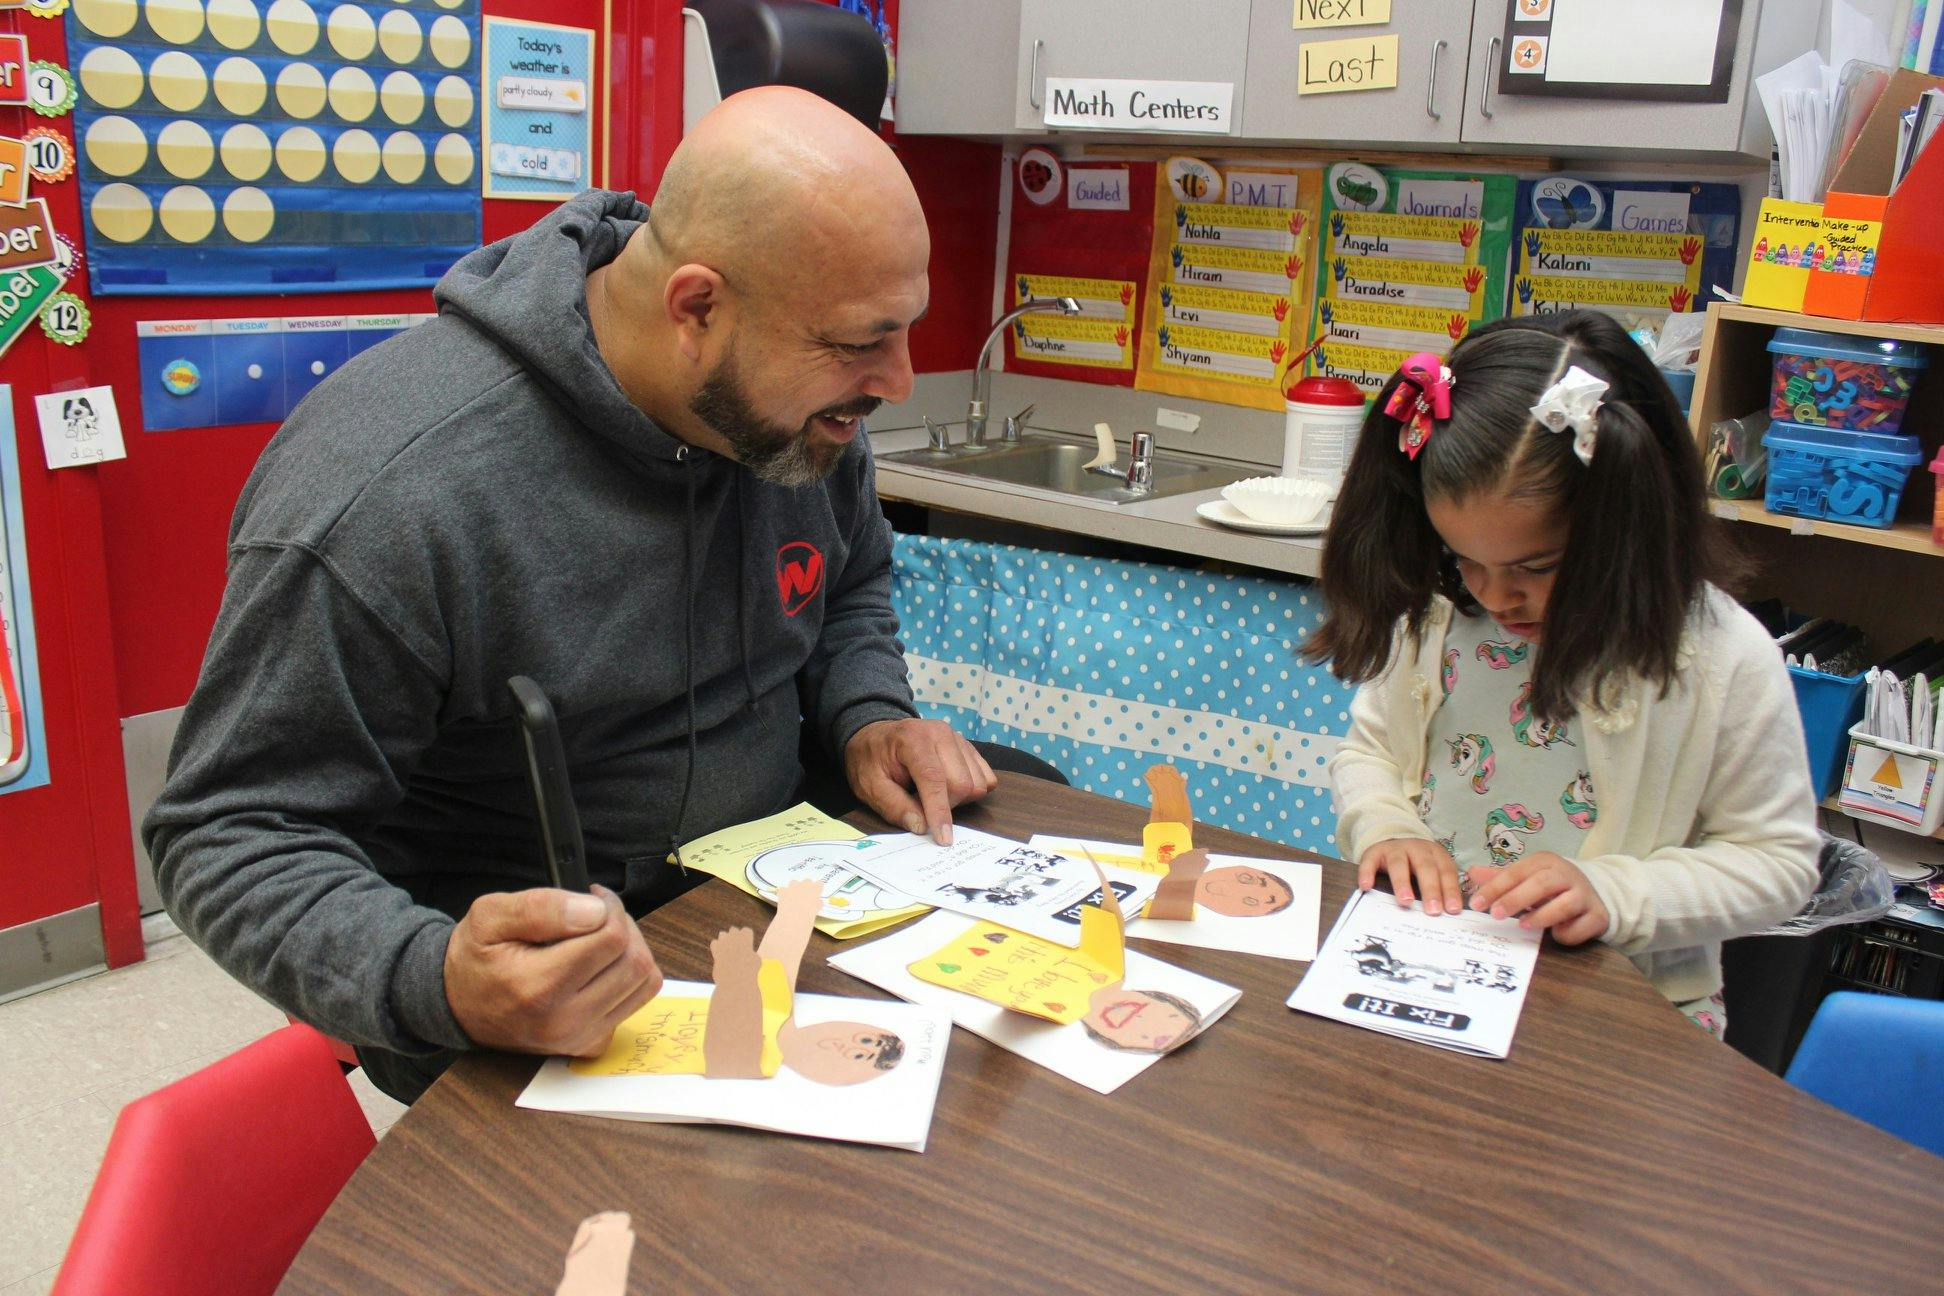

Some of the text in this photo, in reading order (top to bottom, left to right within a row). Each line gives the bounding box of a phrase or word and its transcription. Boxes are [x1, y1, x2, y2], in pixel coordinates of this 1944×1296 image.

[1299, 0, 1366, 21] Next
[517, 37, 562, 54] Today's
[1524, 48, 1532, 59] 4
[509, 60, 570, 75] weather is
[1304, 45, 1384, 85] Last
[38, 77, 53, 101] 9
[503, 84, 552, 101] partly cloudy
[1053, 88, 1220, 121] Math Centers
[529, 123, 552, 134] and
[33, 141, 59, 169] 10
[522, 155, 547, 170] cold
[1076, 179, 1121, 201] Guided
[1404, 191, 1478, 218] Journals
[1621, 205, 1684, 233] Games
[1342, 233, 1389, 256] Angela
[1538, 253, 1592, 271] Kalani
[1182, 265, 1222, 282] Hiram
[1344, 276, 1405, 298] Paradise
[54, 305, 78, 331] 12
[1172, 305, 1199, 322] Levi
[154, 318, 401, 333] MONDAY TUESDAY WEDNESDAY THURSDAY
[1023, 335, 1065, 352] Daphne
[1166, 343, 1211, 365] Shyann
[1325, 364, 1384, 387] Brandon
[778, 552, 823, 605] N
[1878, 784, 1893, 793] Yellow
[1358, 996, 1456, 1028] Fix It!
